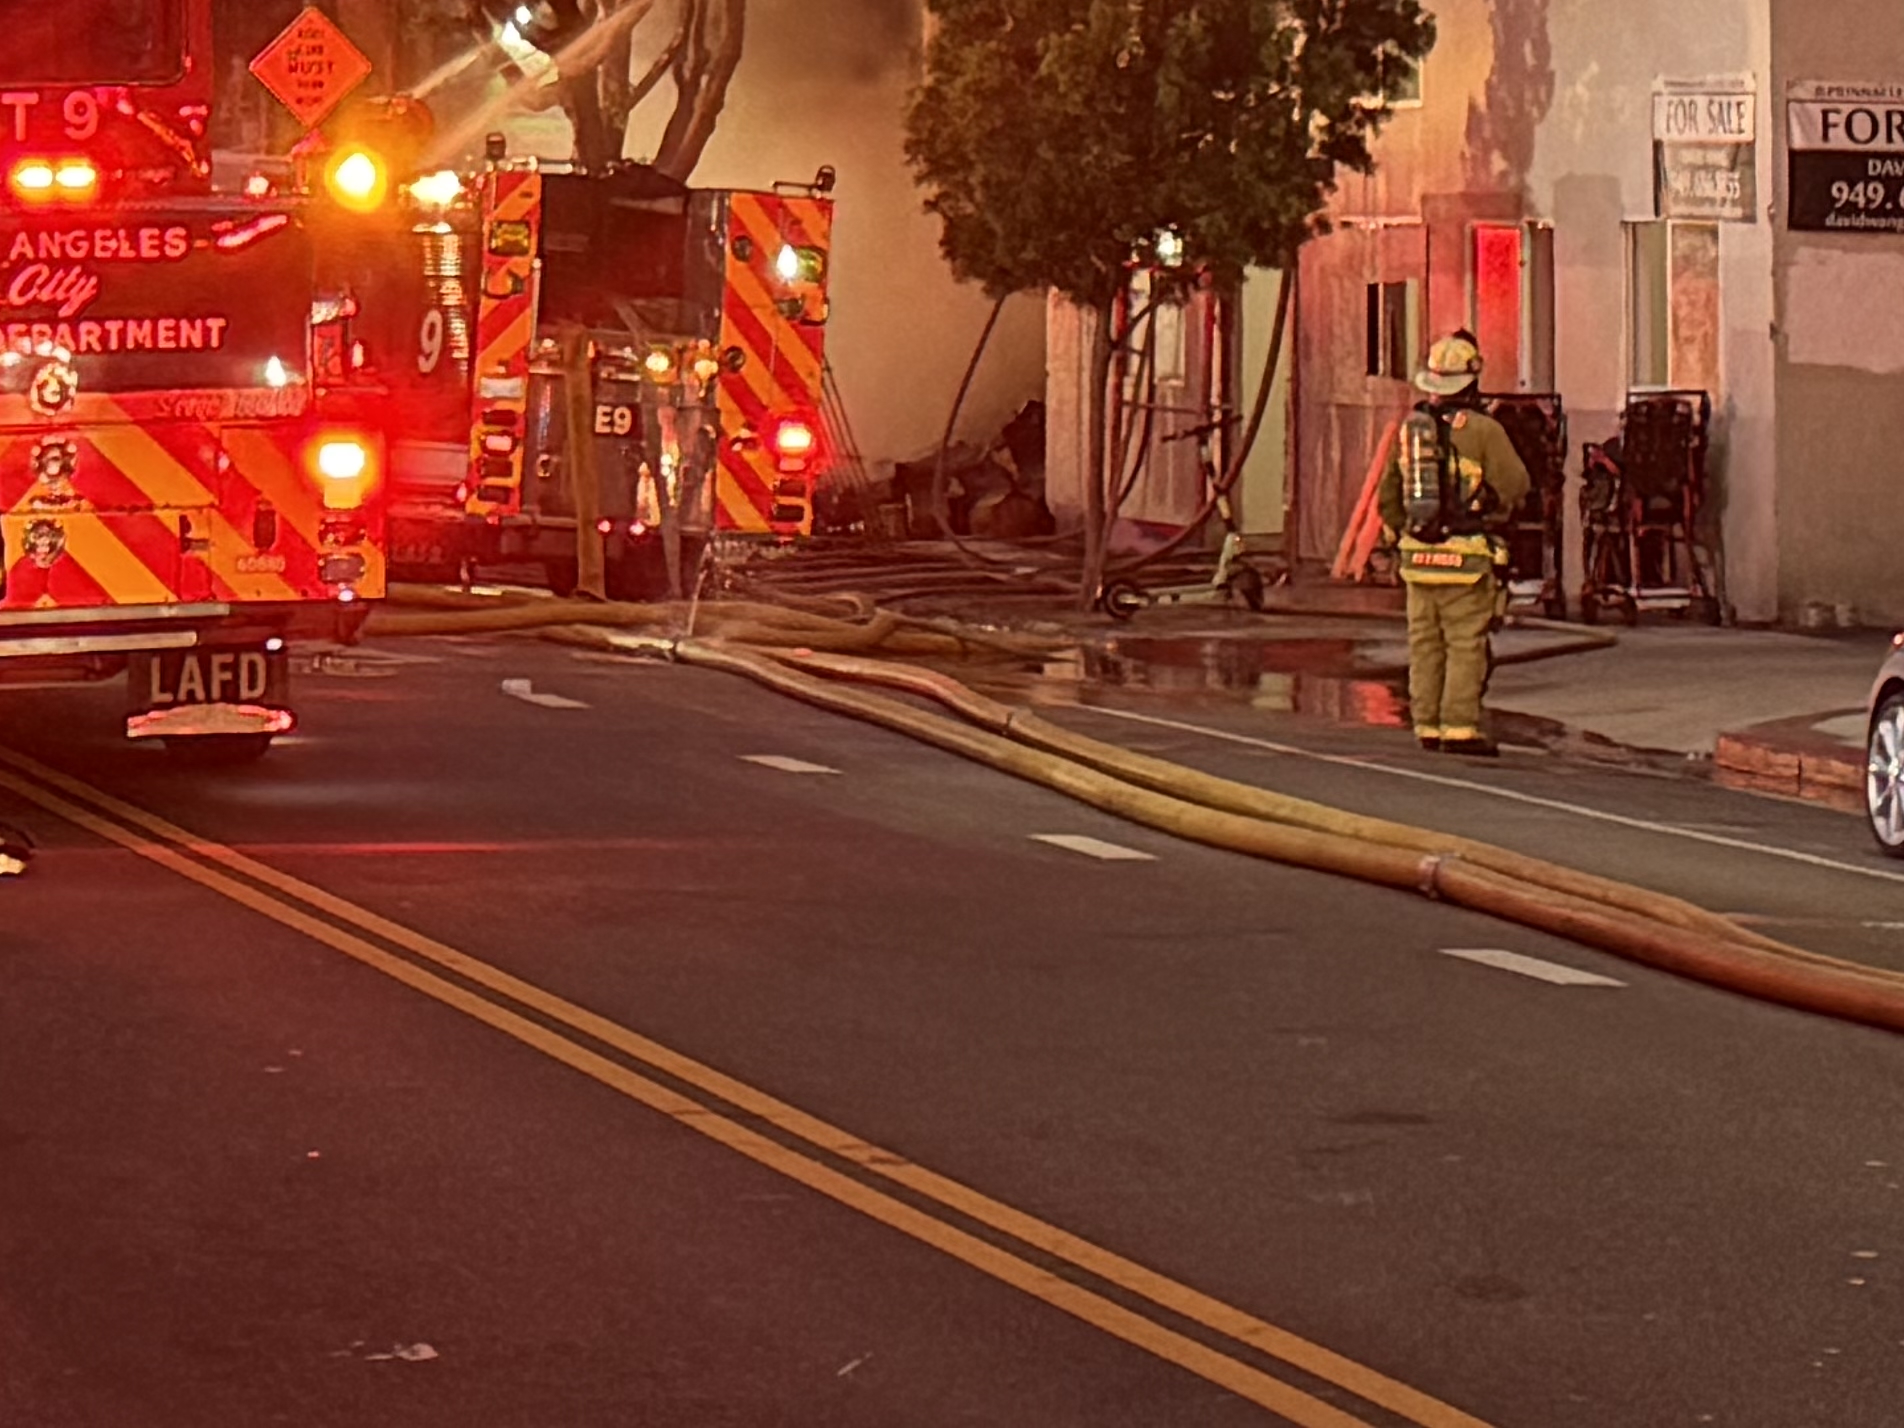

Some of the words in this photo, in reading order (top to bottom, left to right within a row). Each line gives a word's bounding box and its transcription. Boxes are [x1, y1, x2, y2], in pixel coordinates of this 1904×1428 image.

[1, 91, 40, 142] T
[62, 89, 100, 140] 9
[1665, 97, 1699, 136] FOR
[1706, 97, 1747, 136] SALE
[9, 226, 188, 261] ANGELES
[7, 262, 99, 318] City
[416, 308, 444, 374] 9
[594, 404, 633, 436] E9
[149, 652, 268, 703] LAFD
